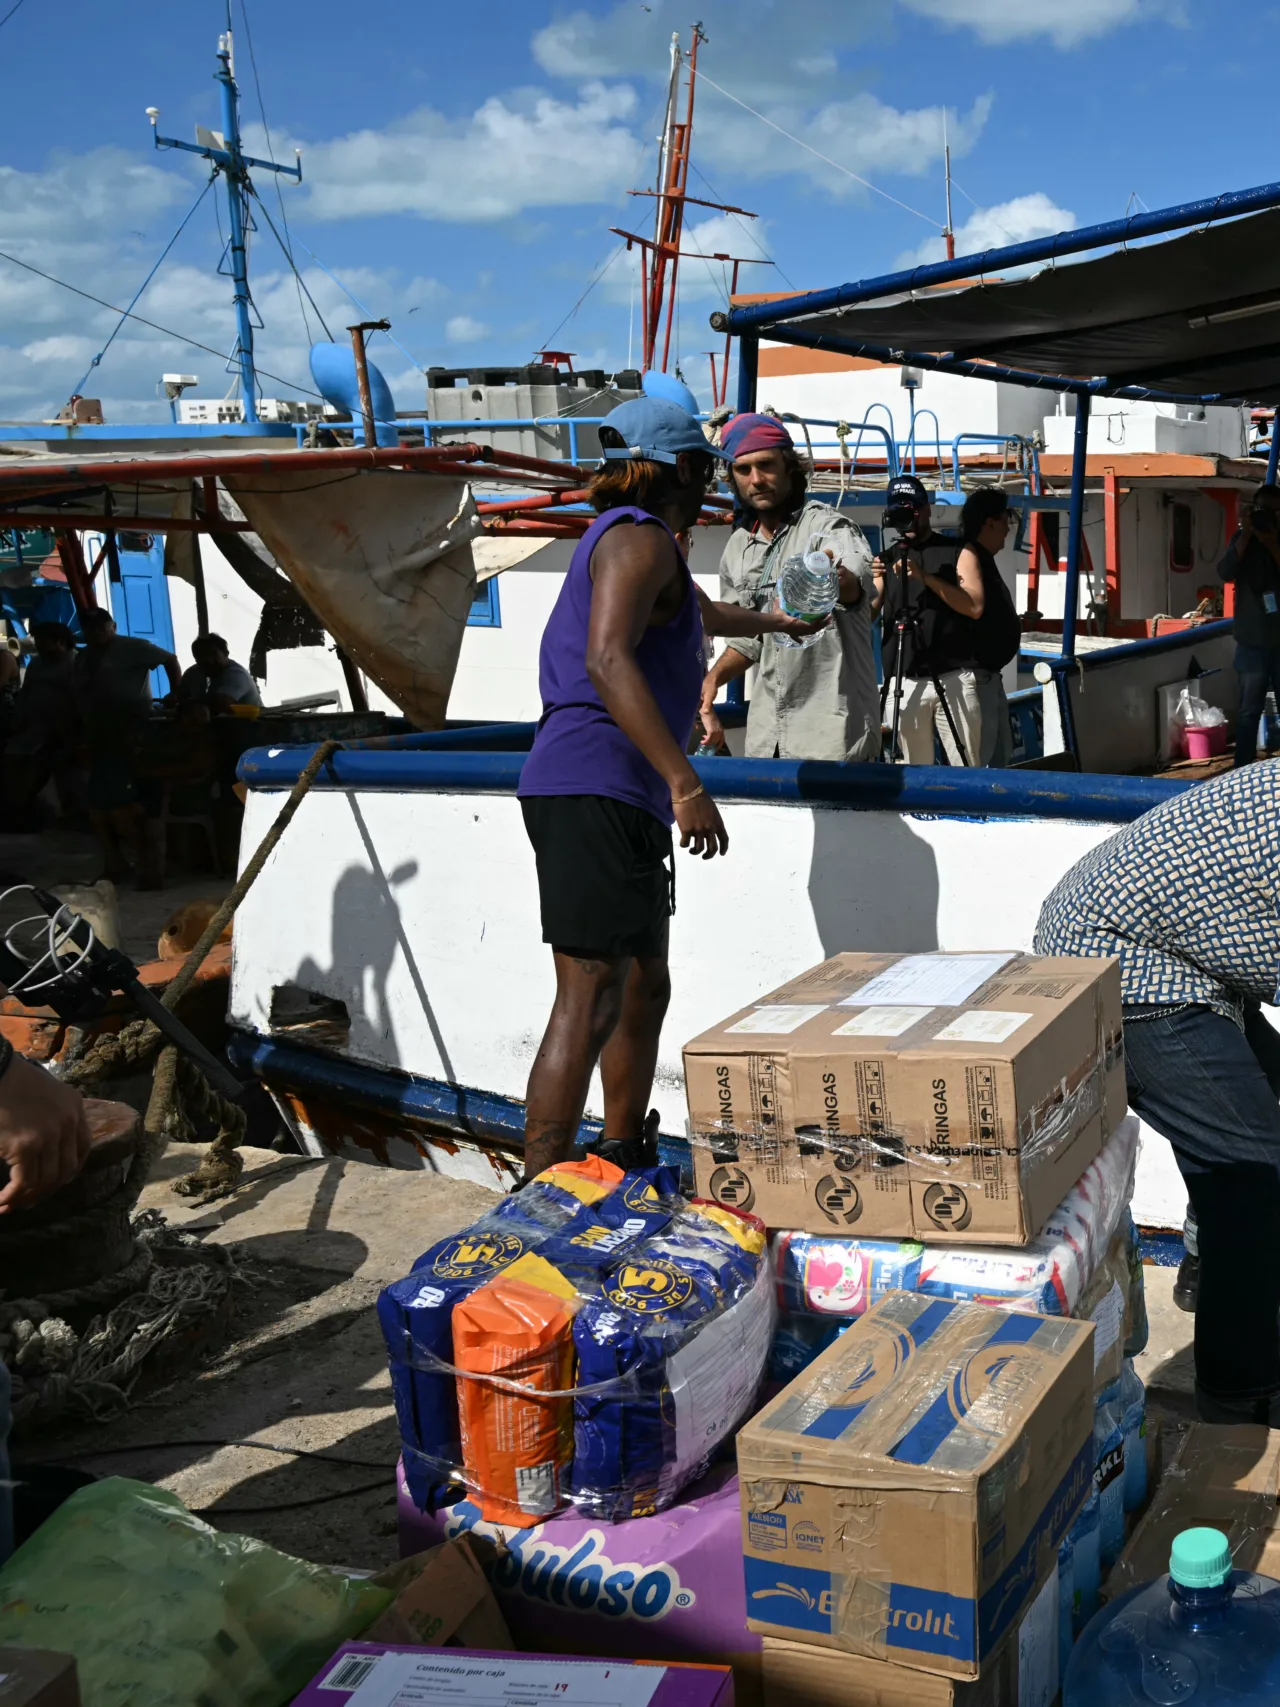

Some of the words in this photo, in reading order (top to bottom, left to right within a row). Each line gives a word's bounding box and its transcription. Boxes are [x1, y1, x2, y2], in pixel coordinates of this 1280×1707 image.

[716, 1066, 734, 1129] RINGAS
[822, 1073, 840, 1137] RINGAS
[570, 1225, 612, 1248] SAN
[589, 1218, 646, 1253] LAZARO
[455, 1244, 497, 1264] 5
[621, 1266, 668, 1292] 5
[663, 1292, 683, 1305] DE
[751, 1513, 783, 1525] AENOR
[795, 1533, 825, 1545] IQNET
[446, 1500, 676, 1618] Fbuloso
[818, 1590, 955, 1638] Etrolit
[416, 1664, 464, 1675] Contenido
[466, 1669, 484, 1677] por
[485, 1670, 505, 1678] caja
[553, 1682, 568, 1692] 19
